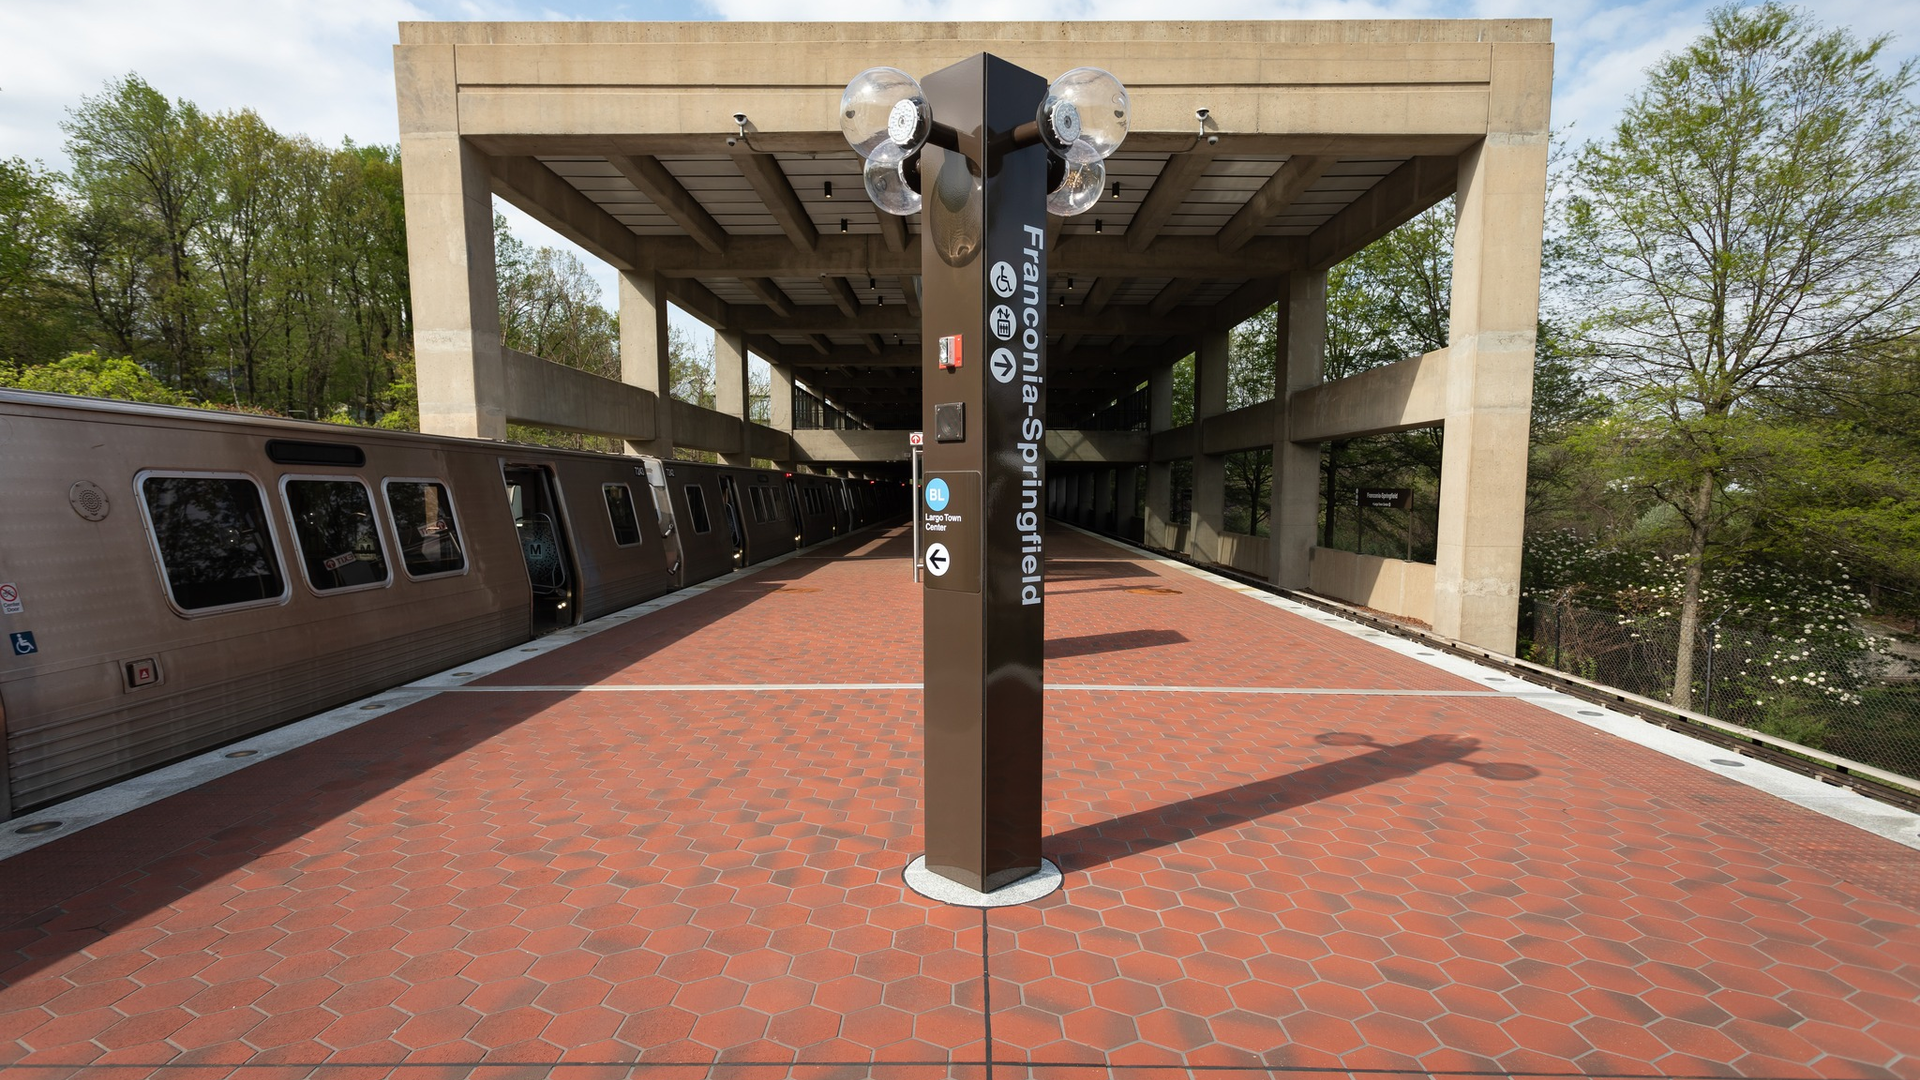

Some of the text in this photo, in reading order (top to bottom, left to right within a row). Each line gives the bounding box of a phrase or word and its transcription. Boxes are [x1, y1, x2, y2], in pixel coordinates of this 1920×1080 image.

[1016, 224, 1044, 606] Franconia-Springfield
[929, 488, 945, 501] BL
[925, 513, 962, 523] Largo Town
[925, 522, 947, 532] Center
